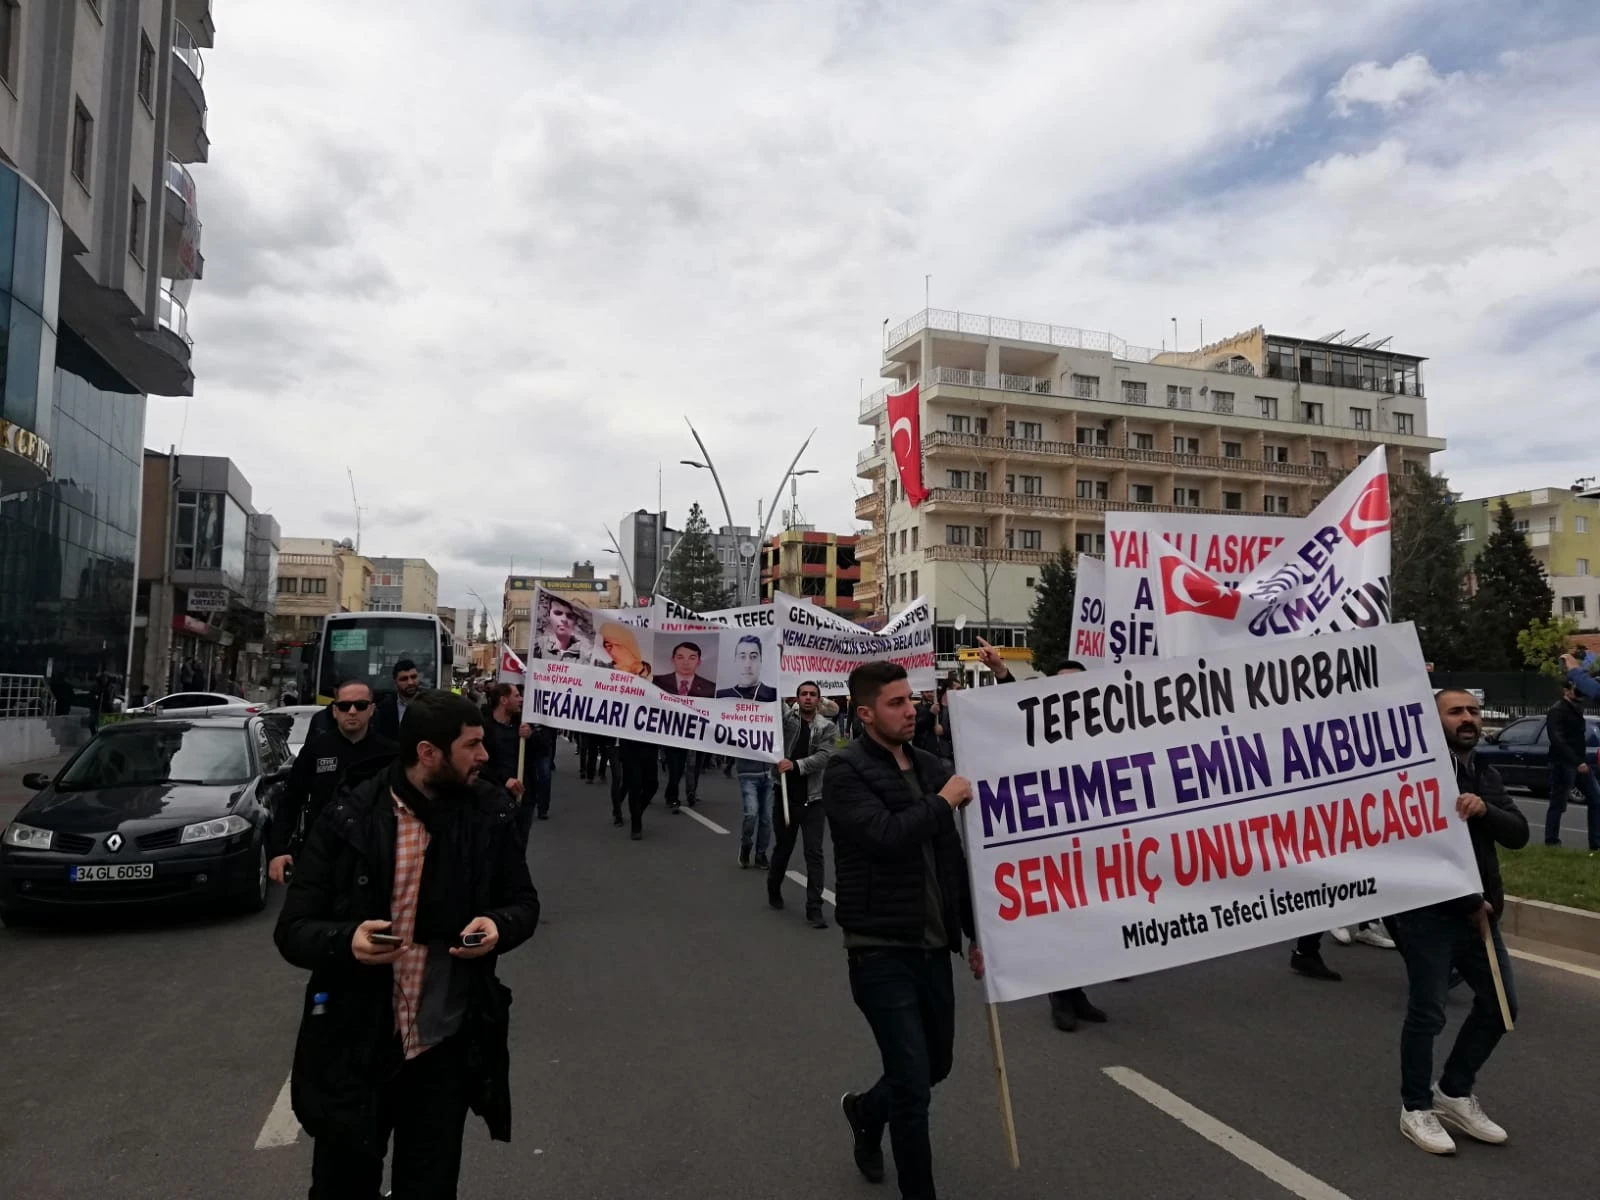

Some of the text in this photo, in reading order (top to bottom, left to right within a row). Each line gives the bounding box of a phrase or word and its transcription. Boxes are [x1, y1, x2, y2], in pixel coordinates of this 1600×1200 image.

[734, 609, 774, 627] TEFEC
[1080, 597, 1105, 625] SO
[893, 633, 913, 651] BELA
[1075, 627, 1105, 657] FAKİ
[1110, 613, 1159, 663] ŞİF
[547, 663, 570, 673] ŞEHİT
[610, 673, 635, 683] ŞEHİT
[594, 681, 617, 692] Murat
[1017, 644, 1379, 748] TEFECİLERİN KURBANI
[533, 688, 774, 753] MEKÂNLARI CENNET OLSUN
[735, 703, 760, 712] ŞEHİT
[977, 702, 1428, 837] MEHMET EMİN AKBULUT
[994, 771, 1448, 921] SENİ HİÇ UNUTMAYACAĞIZ
[78, 864, 152, 880] 34 GL 6059
[1122, 877, 1377, 949] Midyatta Tefeci İstemiyoruz
